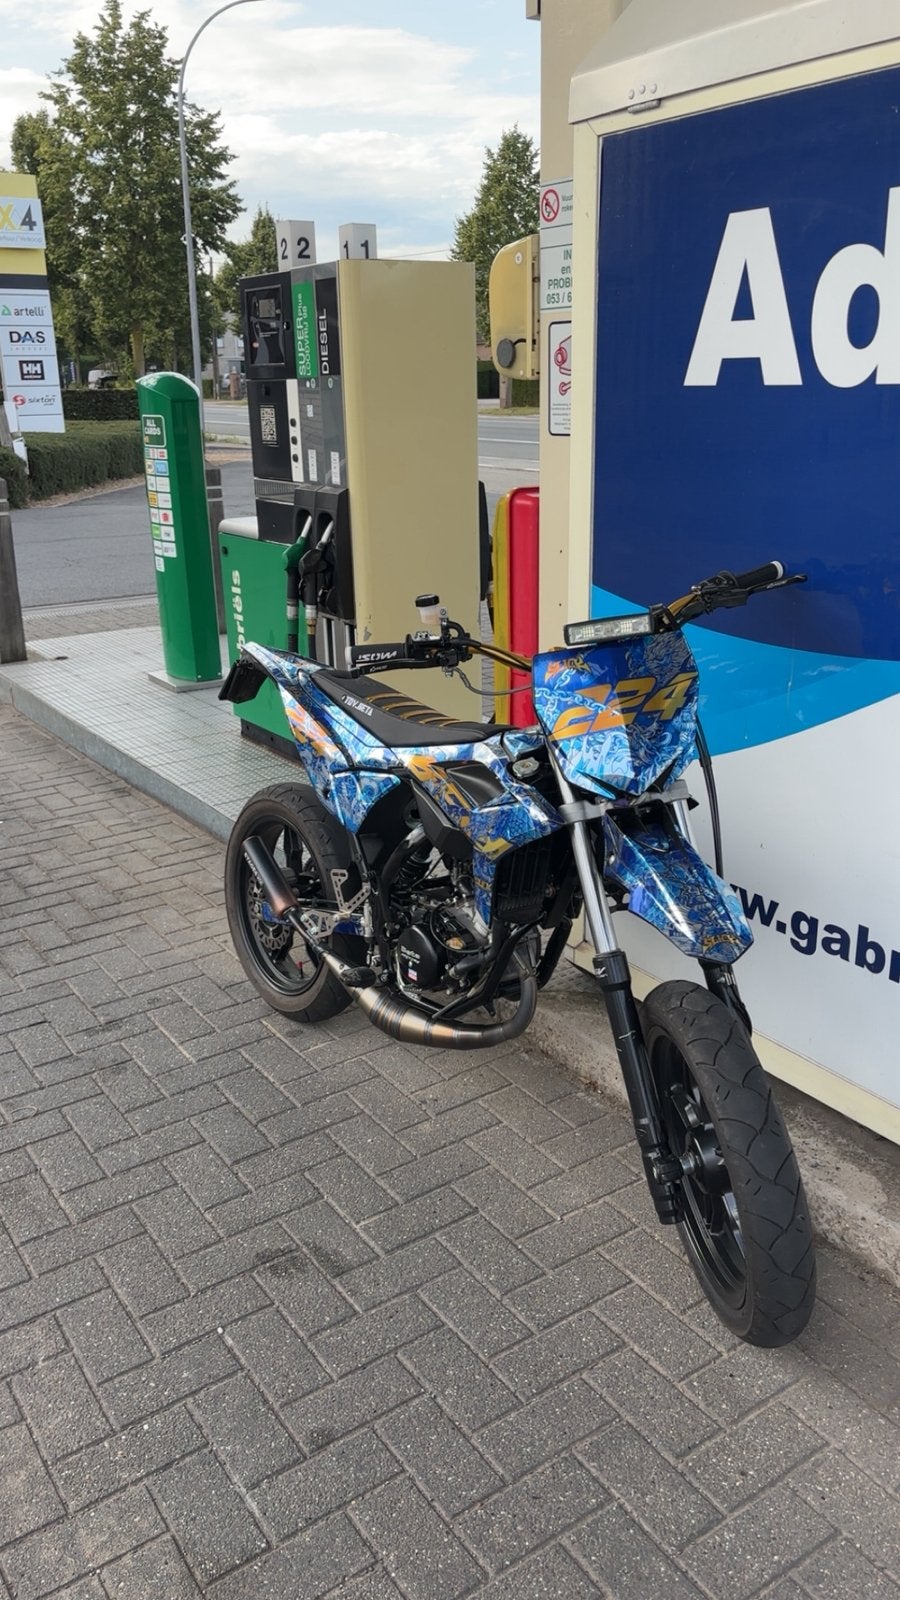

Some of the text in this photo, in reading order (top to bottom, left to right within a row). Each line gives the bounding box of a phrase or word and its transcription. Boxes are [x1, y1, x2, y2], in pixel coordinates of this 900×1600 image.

[280, 238, 288, 260] 2
[297, 236, 311, 259] 2
[360, 239, 370, 259] 1
[546, 293, 560, 304] 053
[14, 306, 44, 316] artelli
[9, 331, 45, 343] DAS
[319, 308, 330, 375] DIESEL
[231, 569, 246, 658] briëls
[549, 671, 698, 741] 224
[730, 883, 900, 984] w.gabr
